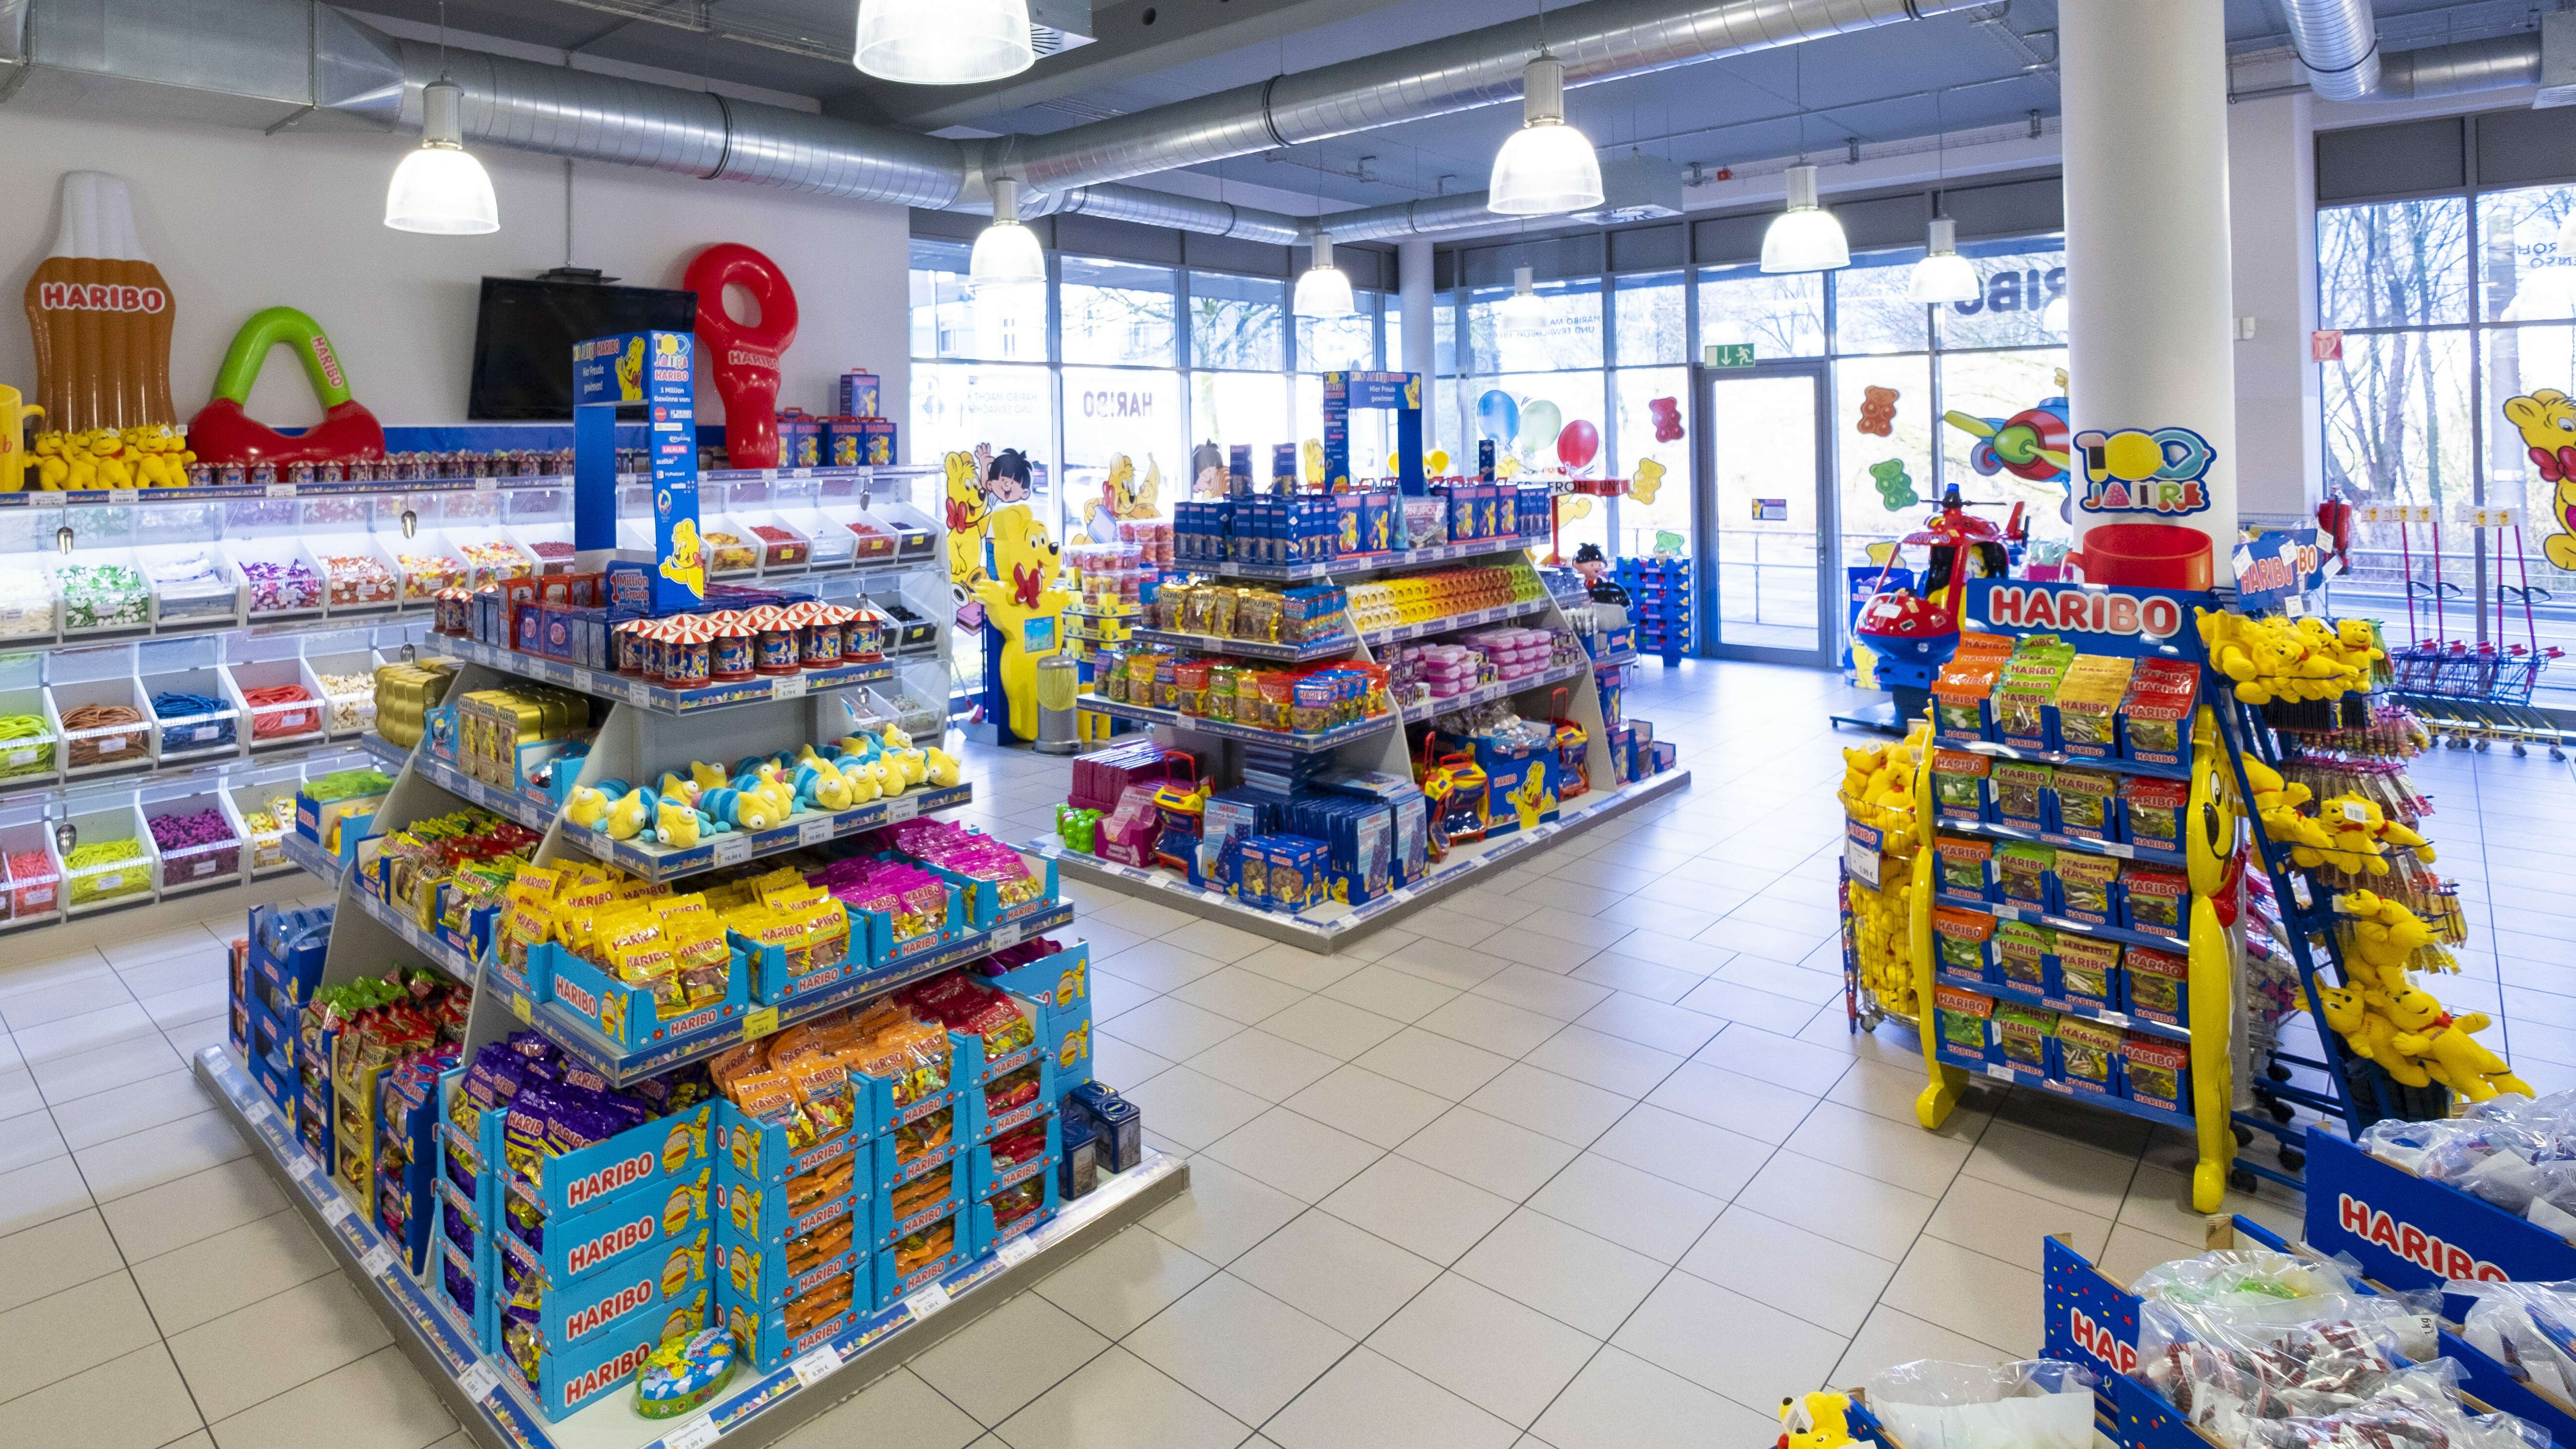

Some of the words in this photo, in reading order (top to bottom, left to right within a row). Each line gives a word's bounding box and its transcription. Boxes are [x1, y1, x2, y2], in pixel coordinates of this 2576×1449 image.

[41, 282, 165, 313] HARIBO
[312, 337, 343, 388] HARIBO
[655, 370, 689, 382] HARIBO
[2077, 431, 2212, 483] 100
[2083, 481, 2207, 512] JAHRE
[610, 572, 619, 603] 1
[619, 574, 648, 588] Million
[625, 589, 649, 601] Freude
[1989, 585, 2181, 638] HARIBO
[1964, 638, 2009, 651] HARIBO
[2011, 664, 2056, 676] HARIBO
[459, 697, 475, 712] HARIBO
[2001, 692, 2046, 704] HARIBO
[2061, 700, 2110, 713] HARIBO
[478, 705, 496, 718] HARIBO
[499, 710, 517, 724] HARIBO
[2122, 705, 2180, 720] HARIBO
[1945, 730, 1980, 740] HARIBO
[2006, 737, 2043, 749] HARIBO
[2065, 745, 2105, 757] HARIBO
[2135, 752, 2177, 764] HARIBO
[1936, 759, 1982, 773] HARIBO
[1998, 767, 2046, 782] HARIBO
[1494, 774, 1517, 788] HARIBO
[2058, 777, 2104, 793] HARIBO
[527, 787, 546, 804] HARIBO
[2126, 795, 2177, 808] HARIBO
[298, 808, 316, 828] HARIBO
[1943, 809, 1978, 820] HARIBO
[2003, 818, 2040, 830] HARIBO
[2063, 827, 2103, 840] HARIBO
[1242, 848, 1264, 859] HARIBO
[1939, 845, 1987, 860] HARIBO
[2133, 838, 2175, 851] HARIBO
[1270, 854, 1293, 867] HARIBO
[2000, 855, 2046, 870] HARIBO
[459, 870, 493, 891] HARIBO
[518, 874, 552, 891] HARIBO
[2127, 880, 2179, 896] HARIBO
[567, 890, 613, 909] HARIBO
[864, 893, 900, 913] HARIBO
[904, 882, 942, 904] HARIBO
[1946, 888, 1983, 900] HARIBO
[1007, 901, 1040, 921] HARIBO
[2005, 899, 2043, 913] HARIBO
[514, 912, 542, 937] HARIBO
[2066, 911, 2105, 924] HARIBO
[761, 921, 804, 941] HARIBO
[1937, 920, 1982, 938] HARIBO
[2135, 924, 2177, 938] HARIBO
[447, 931, 464, 950] HARIBO
[678, 937, 723, 958] HARIBO
[901, 934, 938, 957] HARIBO
[1999, 940, 2043, 957] HARIBO
[625, 950, 672, 969] HARIBO
[2062, 954, 2107, 970] HARIBO
[2128, 954, 2181, 976] HARIBO
[502, 968, 523, 988] HARIBO
[798, 968, 839, 993] HARIBO
[1946, 966, 1983, 980] HARIBO
[555, 975, 597, 1018] HARIBO
[2006, 981, 2044, 995] HARIBO
[1939, 994, 1985, 1012] HARIBO
[2065, 995, 2105, 1010] HARIBO
[670, 1009, 717, 1036] HARIBO
[2135, 1009, 2177, 1024] HARIBO
[1999, 1019, 2044, 1037] HARIBO
[2061, 1026, 2111, 1048] HARIBO
[779, 1039, 823, 1067] HARIBO
[1947, 1044, 1984, 1059] HARIBO
[2121, 1046, 2176, 1068] HARIBO
[865, 1051, 906, 1073] HARIBO
[994, 1052, 1027, 1076] HARIBO
[2006, 1061, 2044, 1076] HARIBO
[568, 1069, 606, 1093] HARIBO
[800, 1066, 844, 1088] HARIBO
[2066, 1077, 2105, 1093] HARIBO
[749, 1091, 794, 1112] HARIBO
[903, 1095, 942, 1124] HARIBO
[2134, 1093, 2176, 1110] HARIBO
[507, 1110, 543, 1136] HARIB
[997, 1107, 1033, 1131] HARIBO
[453, 1128, 475, 1156] HARIBO
[547, 1117, 591, 1148] HARIBO
[800, 1140, 844, 1171] HARIBO
[907, 1151, 944, 1179] HARIBO
[568, 1151, 654, 1209] HARIBO
[1002, 1161, 1039, 1187] HARIBO
[511, 1174, 537, 1206] HARIBO
[450, 1187, 472, 1215] HARIBO
[800, 1202, 843, 1233] HARIBO
[903, 1205, 943, 1235] HARIBO
[1002, 1215, 1037, 1241] HARIBO
[511, 1238, 536, 1269] HARIBO
[568, 1215, 655, 1276] HARIBO
[449, 1245, 470, 1273] HARIBO
[799, 1260, 842, 1293] HARIBO
[907, 1261, 945, 1291] HARIBO
[450, 1301, 470, 1332] HARIBO
[566, 1279, 653, 1342] HARIBO
[798, 1320, 842, 1353] HARIBO
[2070, 1307, 2138, 1376] HAR
[507, 1363, 533, 1397] HARIBO
[564, 1342, 651, 1408] HARIBO
